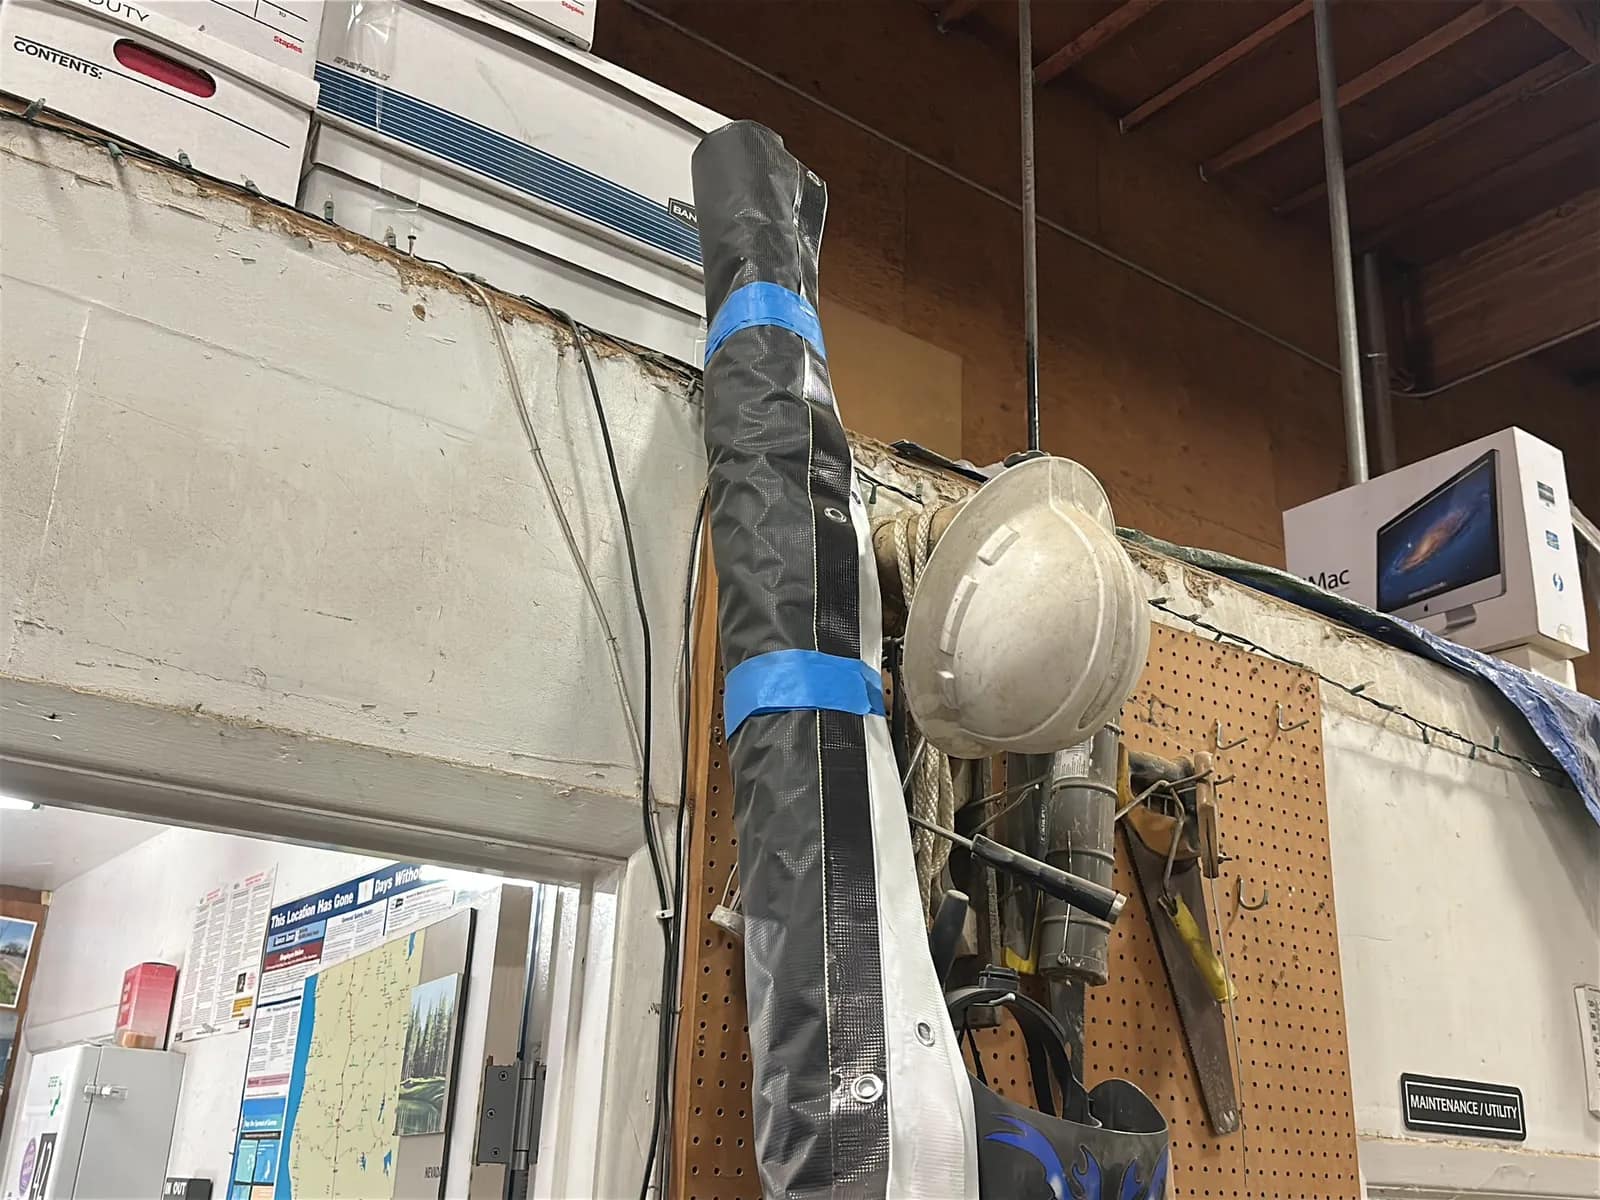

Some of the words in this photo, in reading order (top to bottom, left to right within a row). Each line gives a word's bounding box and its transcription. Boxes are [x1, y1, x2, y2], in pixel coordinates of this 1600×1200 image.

[273, 35, 303, 54] Staples
[14, 40, 103, 80] CONTENTS:
[673, 205, 698, 223] BAN
[1303, 569, 1351, 590] Mac
[271, 912, 287, 929] This
[286, 904, 316, 925] Location
[317, 898, 333, 914] Has
[333, 892, 354, 909] Gone
[374, 877, 394, 895] Days
[1410, 1094, 1479, 1115] MAINTENANCE
[1479, 1102, 1484, 1117] /
[1484, 1103, 1518, 1120] UTILITY
[172, 1181, 187, 1196] OUT
